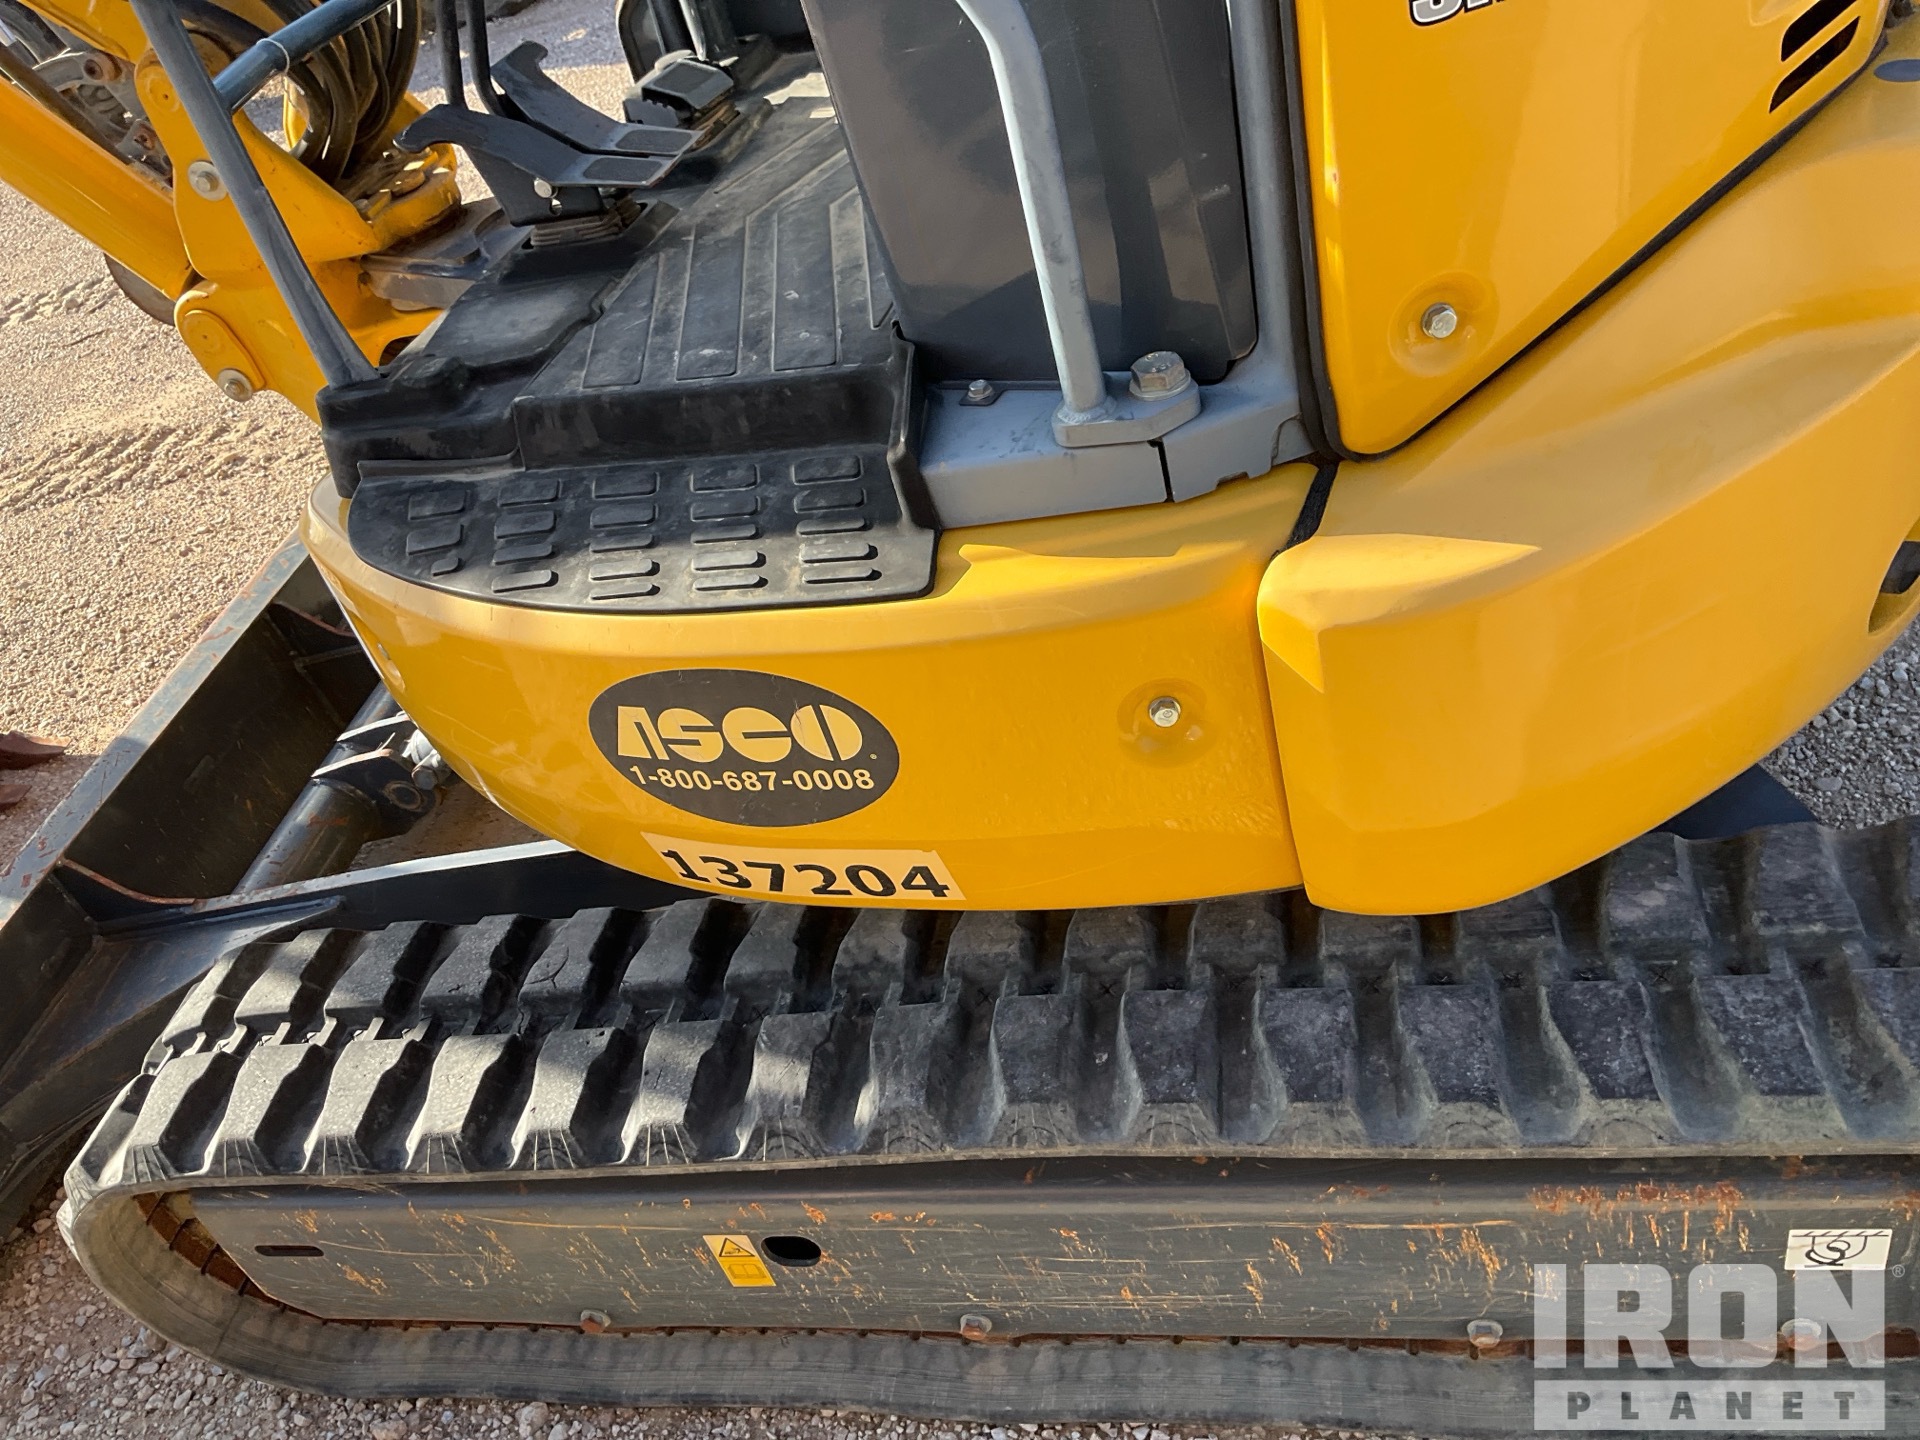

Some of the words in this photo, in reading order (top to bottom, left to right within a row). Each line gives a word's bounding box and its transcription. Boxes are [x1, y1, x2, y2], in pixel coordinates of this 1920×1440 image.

[617, 705, 863, 763] ASCO
[630, 766, 875, 791] 1-800-687-0008
[661, 849, 950, 898] 137204
